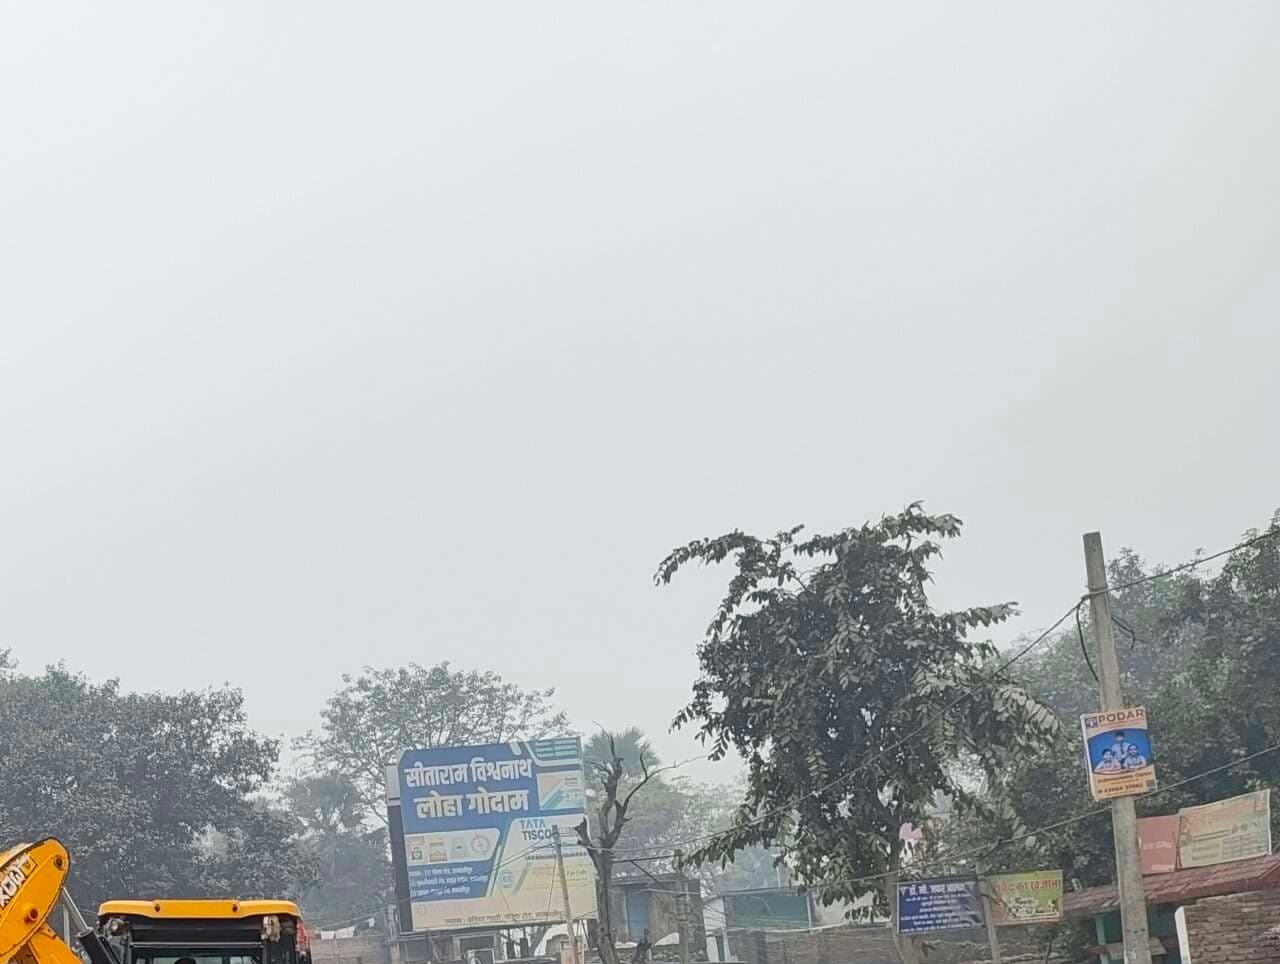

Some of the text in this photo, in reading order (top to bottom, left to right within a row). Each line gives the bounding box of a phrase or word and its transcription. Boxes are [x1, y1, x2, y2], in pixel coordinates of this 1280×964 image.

[1098, 708, 1145, 724] PODAR
[404, 756, 534, 788] सीताराम विश्वनाथ
[413, 789, 463, 820] लोहा
[466, 787, 530, 815] गोदाम
[520, 818, 547, 832] TATA
